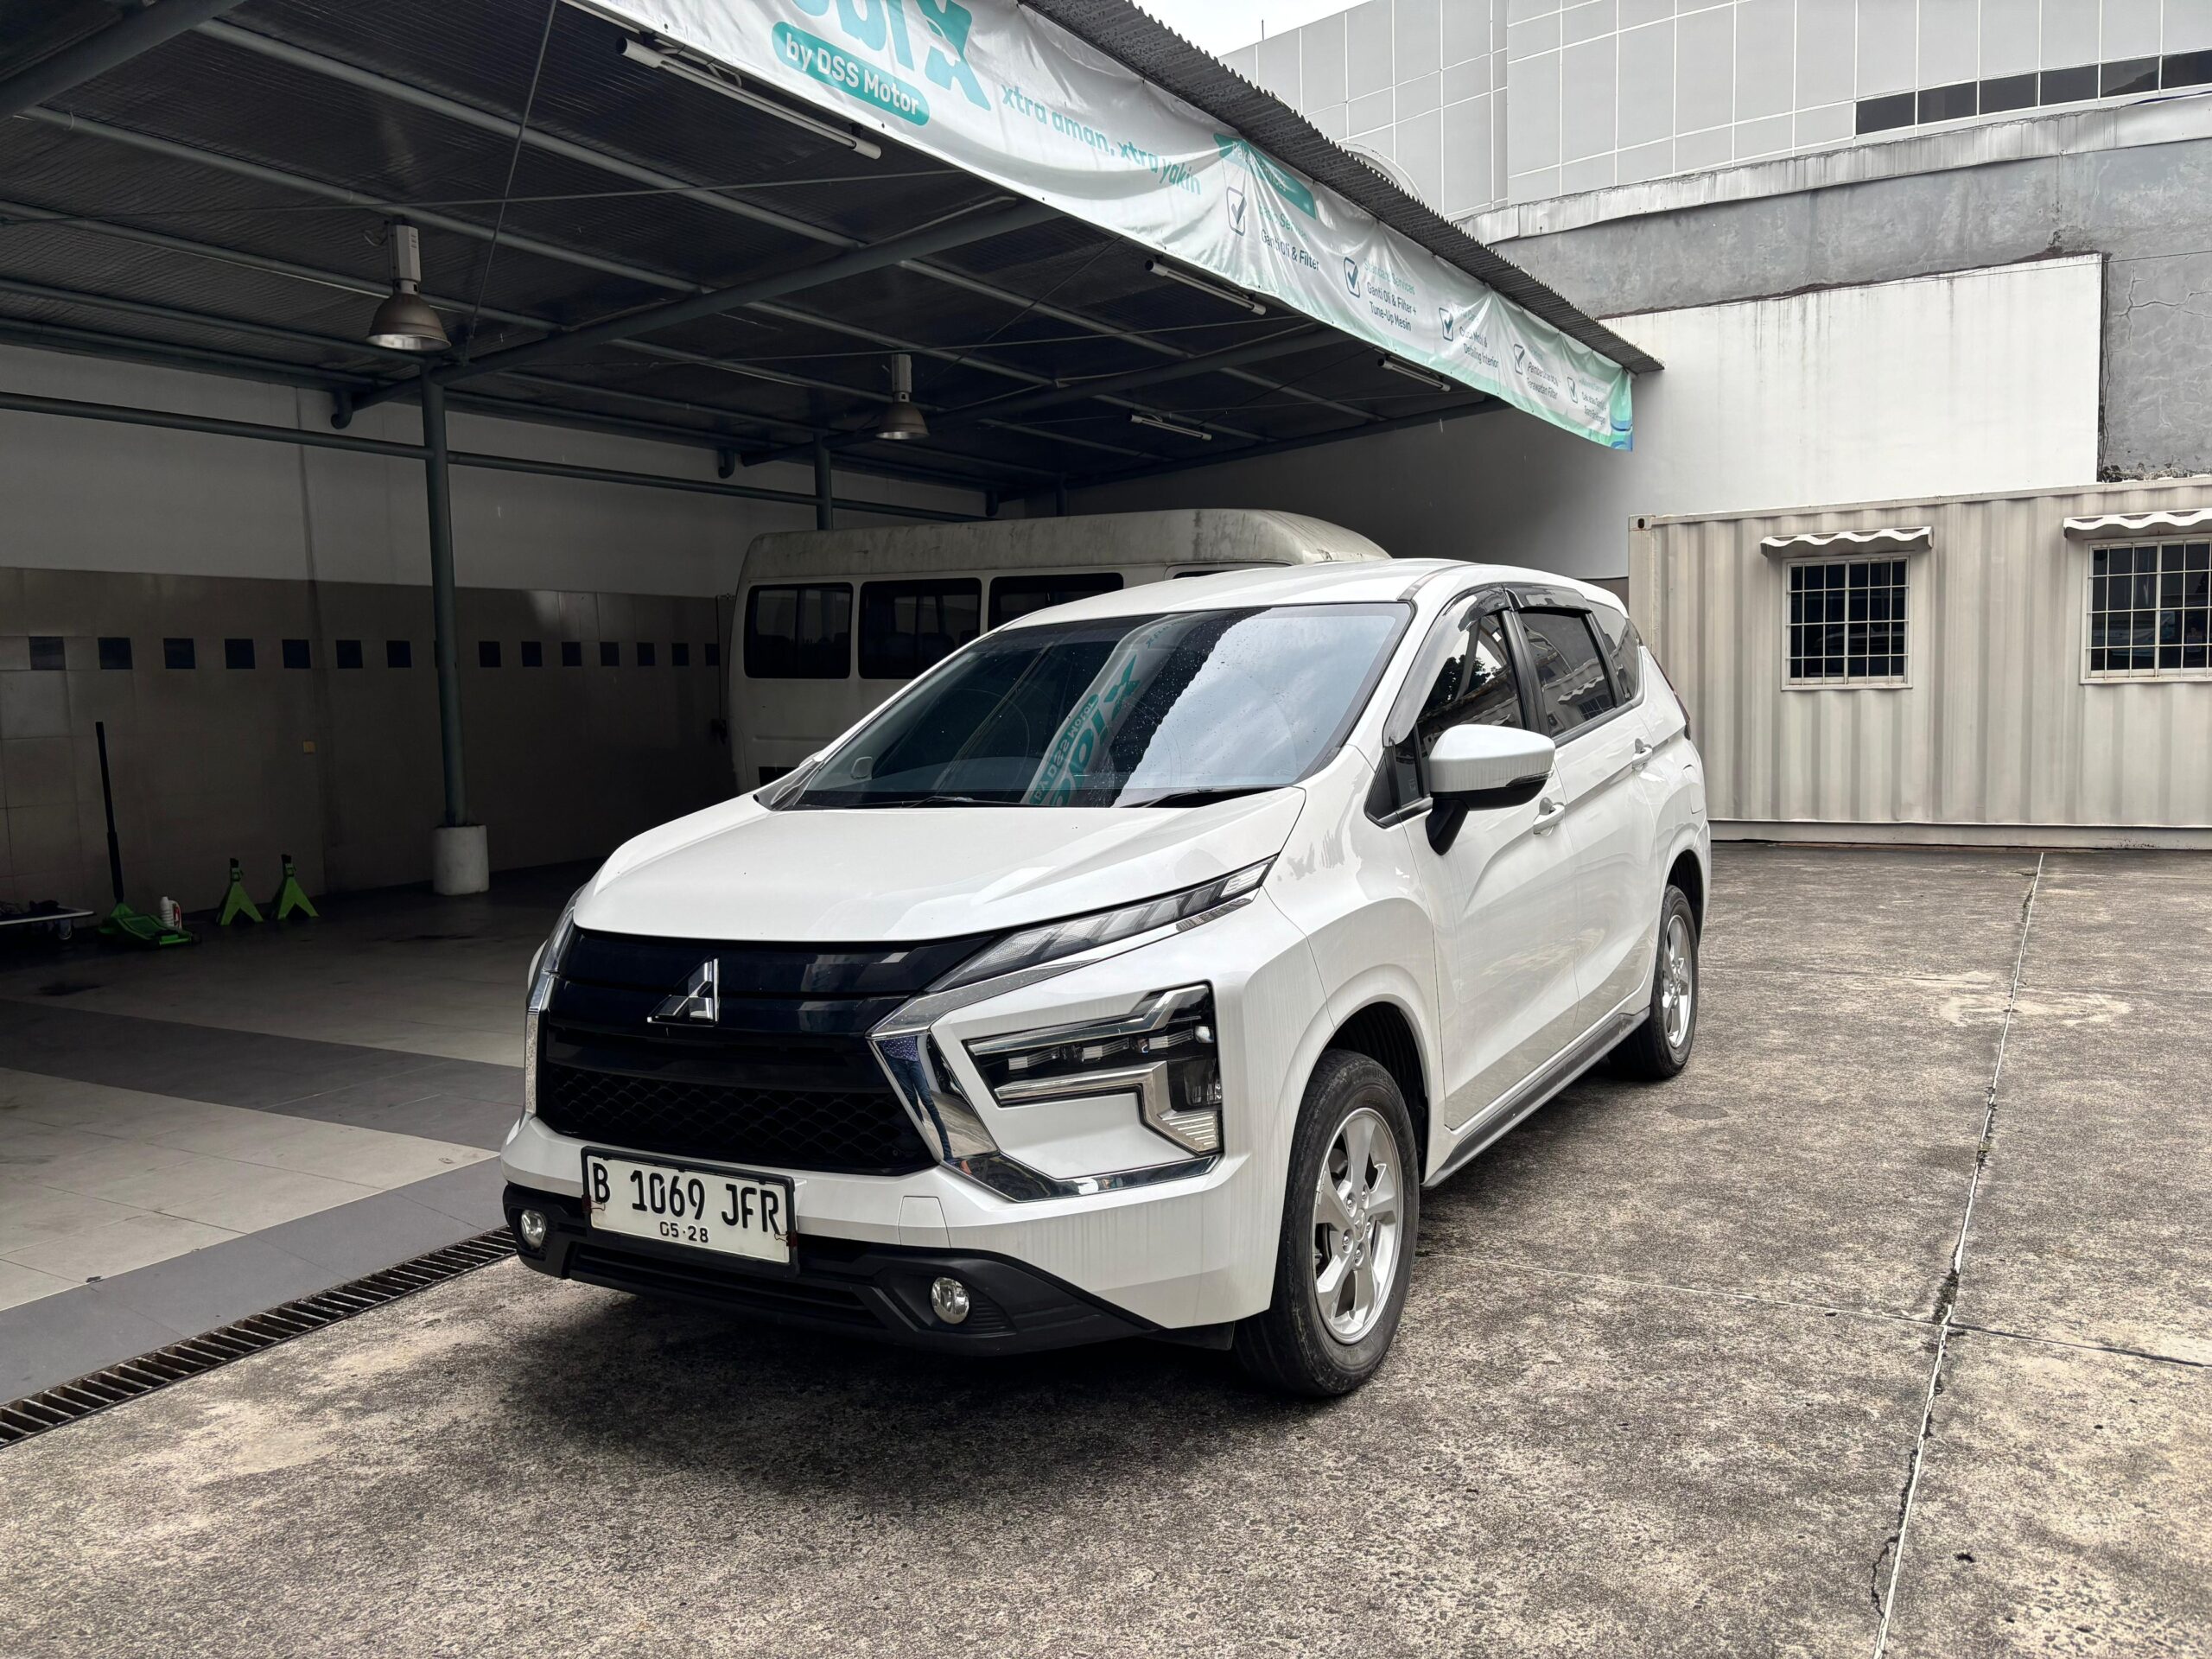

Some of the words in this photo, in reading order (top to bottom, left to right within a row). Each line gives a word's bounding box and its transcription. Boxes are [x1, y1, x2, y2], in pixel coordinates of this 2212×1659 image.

[786, 33, 812, 71] by
[817, 48, 860, 88] DSS
[865, 69, 918, 115] Motor
[1001, 84, 1047, 124] xtra
[1117, 141, 1159, 173] xtra
[1159, 158, 1201, 195] yakin
[1291, 246, 1298, 261] &
[1300, 249, 1319, 271] Filter
[1367, 282, 1382, 300] Ganti
[1391, 295, 1397, 306] &
[1397, 296, 1412, 313] Filter
[1370, 301, 1394, 325] Tune-Up
[1394, 313, 1411, 332] Mesin
[592, 1162, 611, 1203] B
[630, 1169, 706, 1220] 1069
[721, 1183, 781, 1236] JFR
